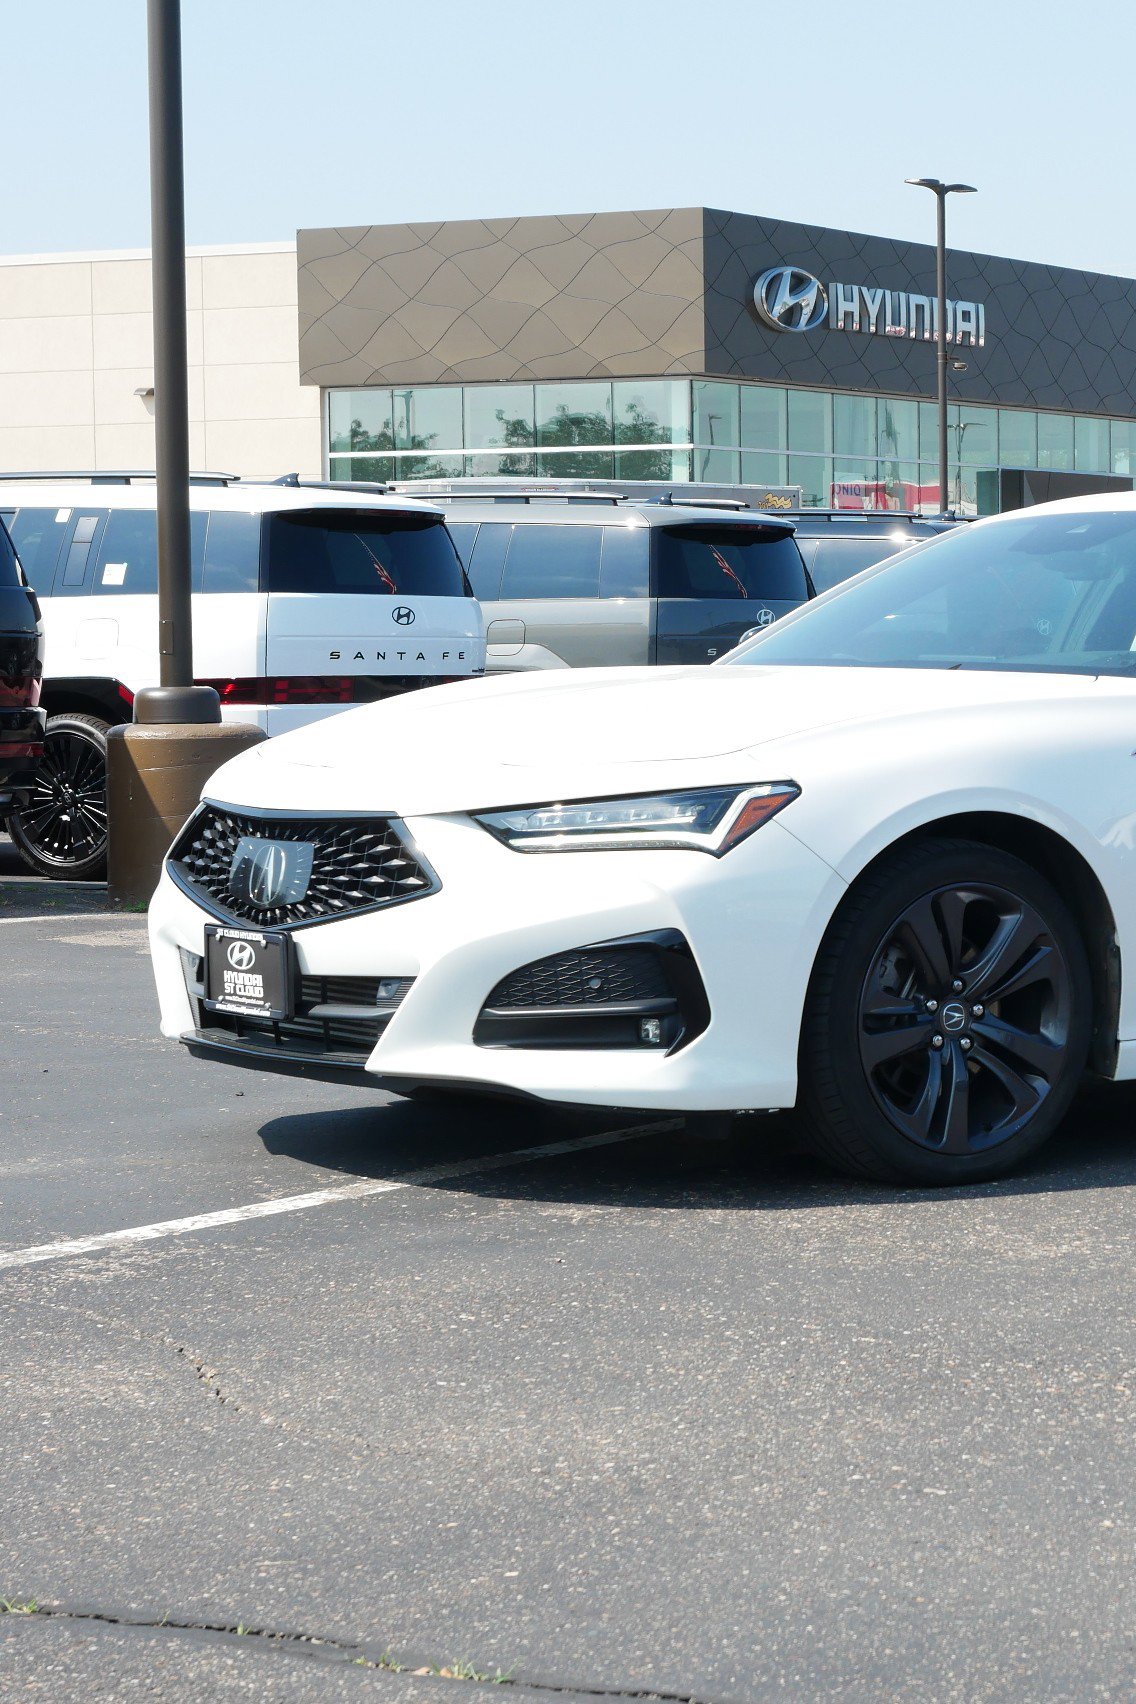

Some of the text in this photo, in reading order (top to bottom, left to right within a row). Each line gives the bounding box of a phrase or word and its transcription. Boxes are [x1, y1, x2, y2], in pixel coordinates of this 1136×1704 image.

[829, 282, 986, 347] HYUNDAI
[329, 651, 466, 661] SANTA FE
[223, 970, 263, 986] HYUNDAI
[224, 982, 264, 998] ST CLOUD
